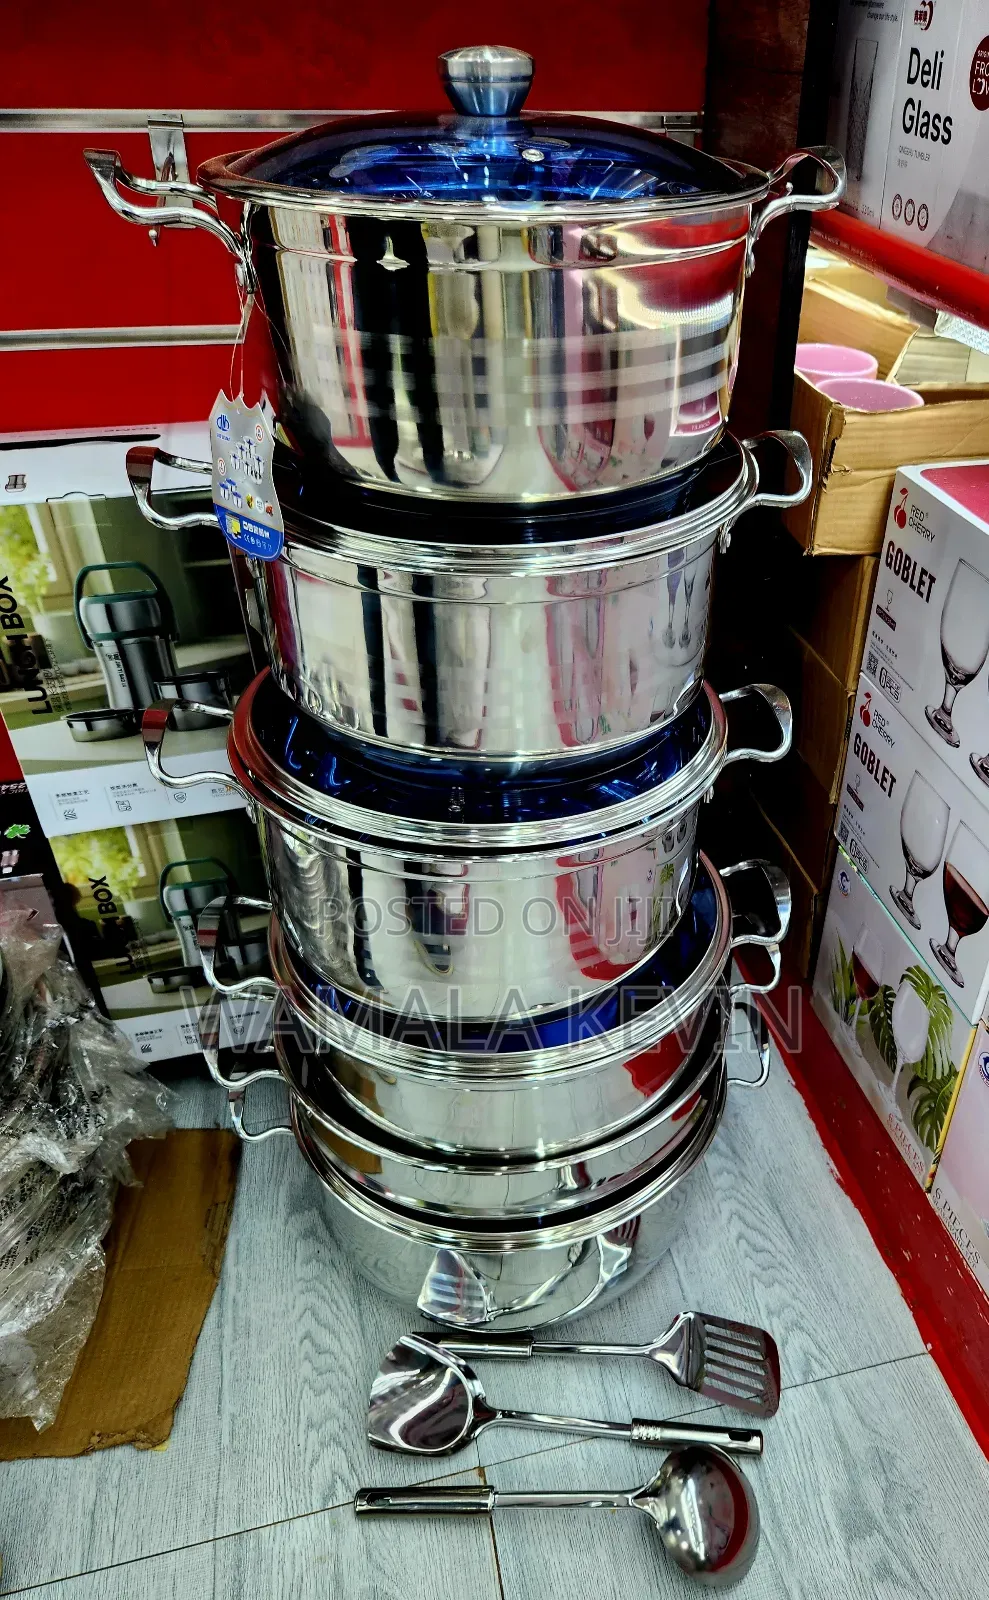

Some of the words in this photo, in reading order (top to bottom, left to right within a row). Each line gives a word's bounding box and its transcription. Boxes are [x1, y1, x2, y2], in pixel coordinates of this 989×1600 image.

[906, 47, 944, 91] Deli
[903, 97, 953, 145] Glass
[908, 516, 936, 543] CHERRY
[910, 504, 925, 521] RED
[885, 540, 937, 604] GOBLET
[871, 719, 895, 748] CHERRY
[873, 709, 886, 727] RED
[854, 733, 896, 798] GOBLET
[88, 876, 117, 914] BOX
[894, 1121, 925, 1172] PIECES
[934, 1187, 942, 1200] 6
[942, 1200, 982, 1264] PIECES
